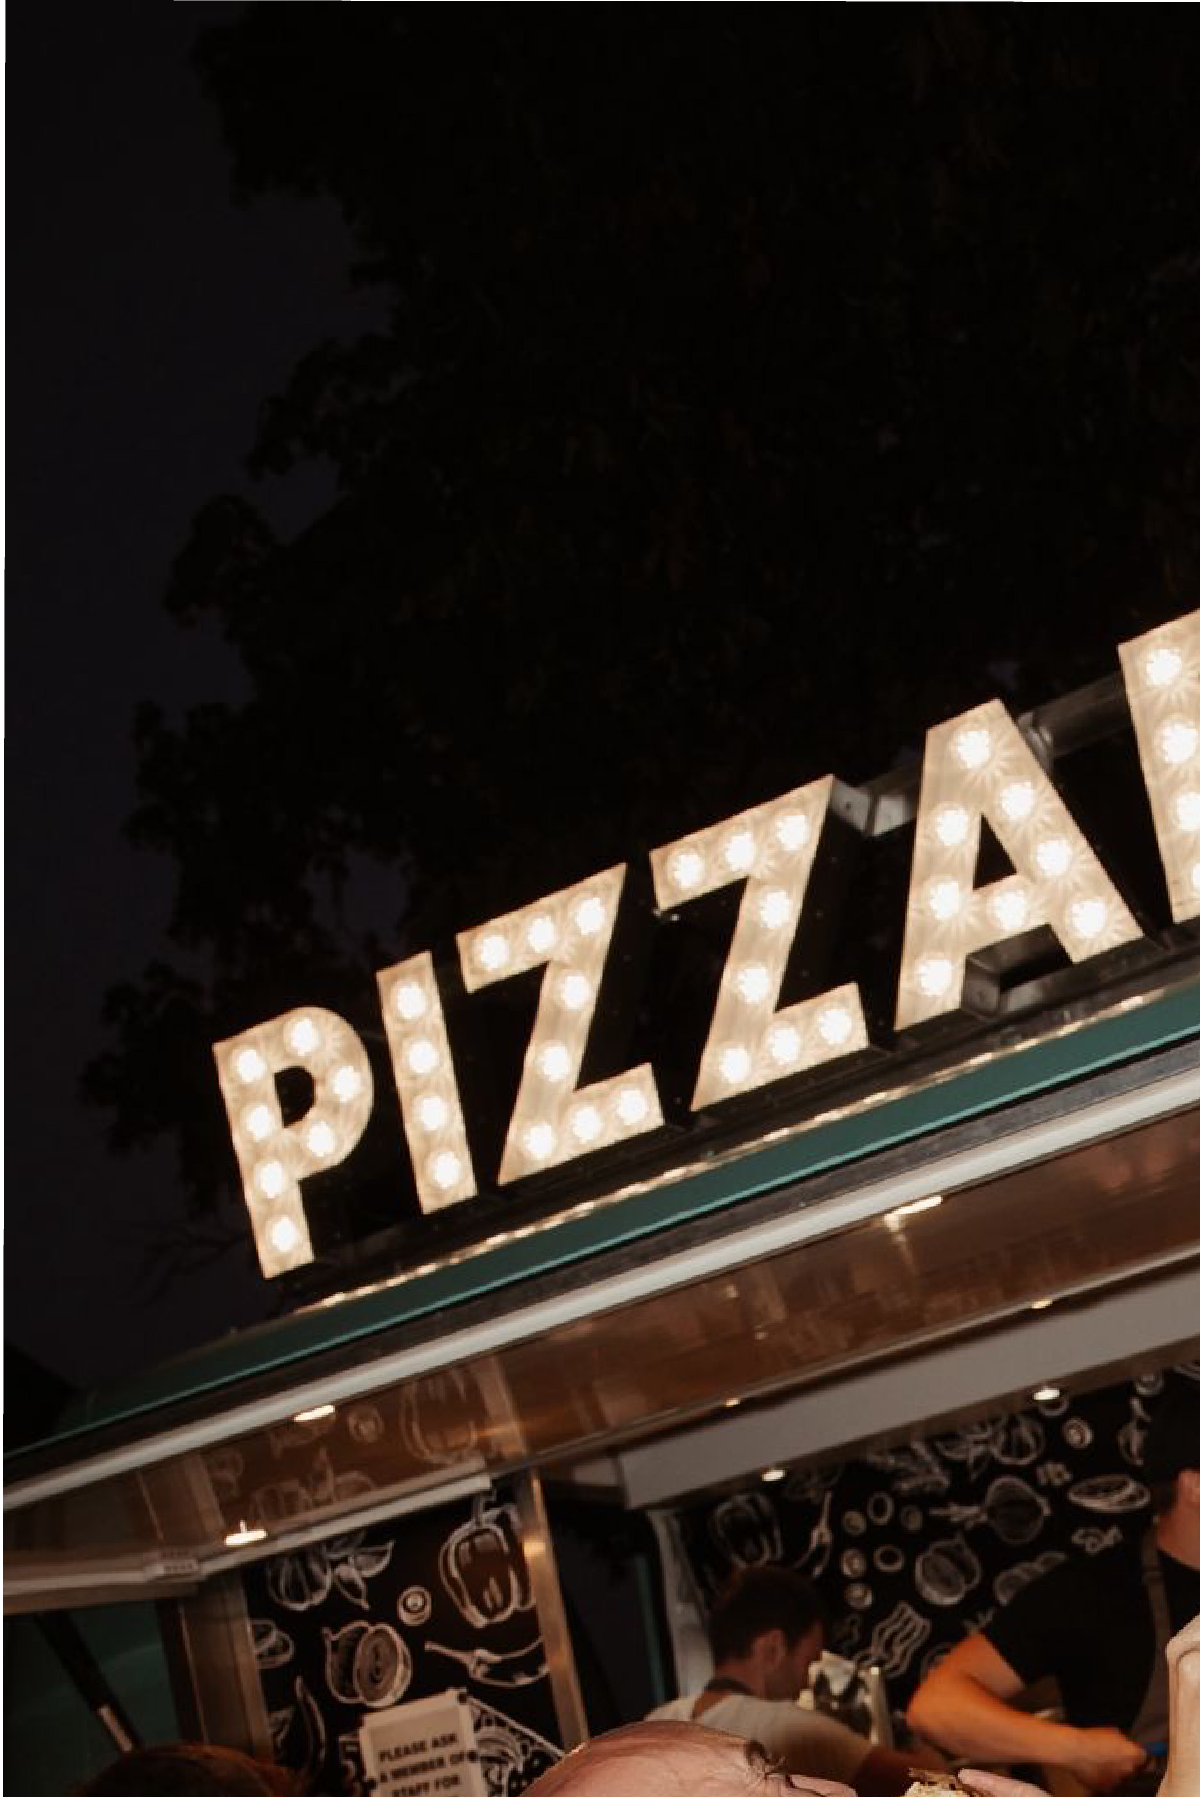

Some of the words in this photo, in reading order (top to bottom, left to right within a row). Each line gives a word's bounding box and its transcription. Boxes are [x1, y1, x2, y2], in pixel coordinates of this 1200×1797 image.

[378, 1740, 427, 1762] PLEASE
[431, 1733, 457, 1749] ASK
[390, 1757, 445, 1779] MEMBER
[434, 1774, 460, 1791] FOR
